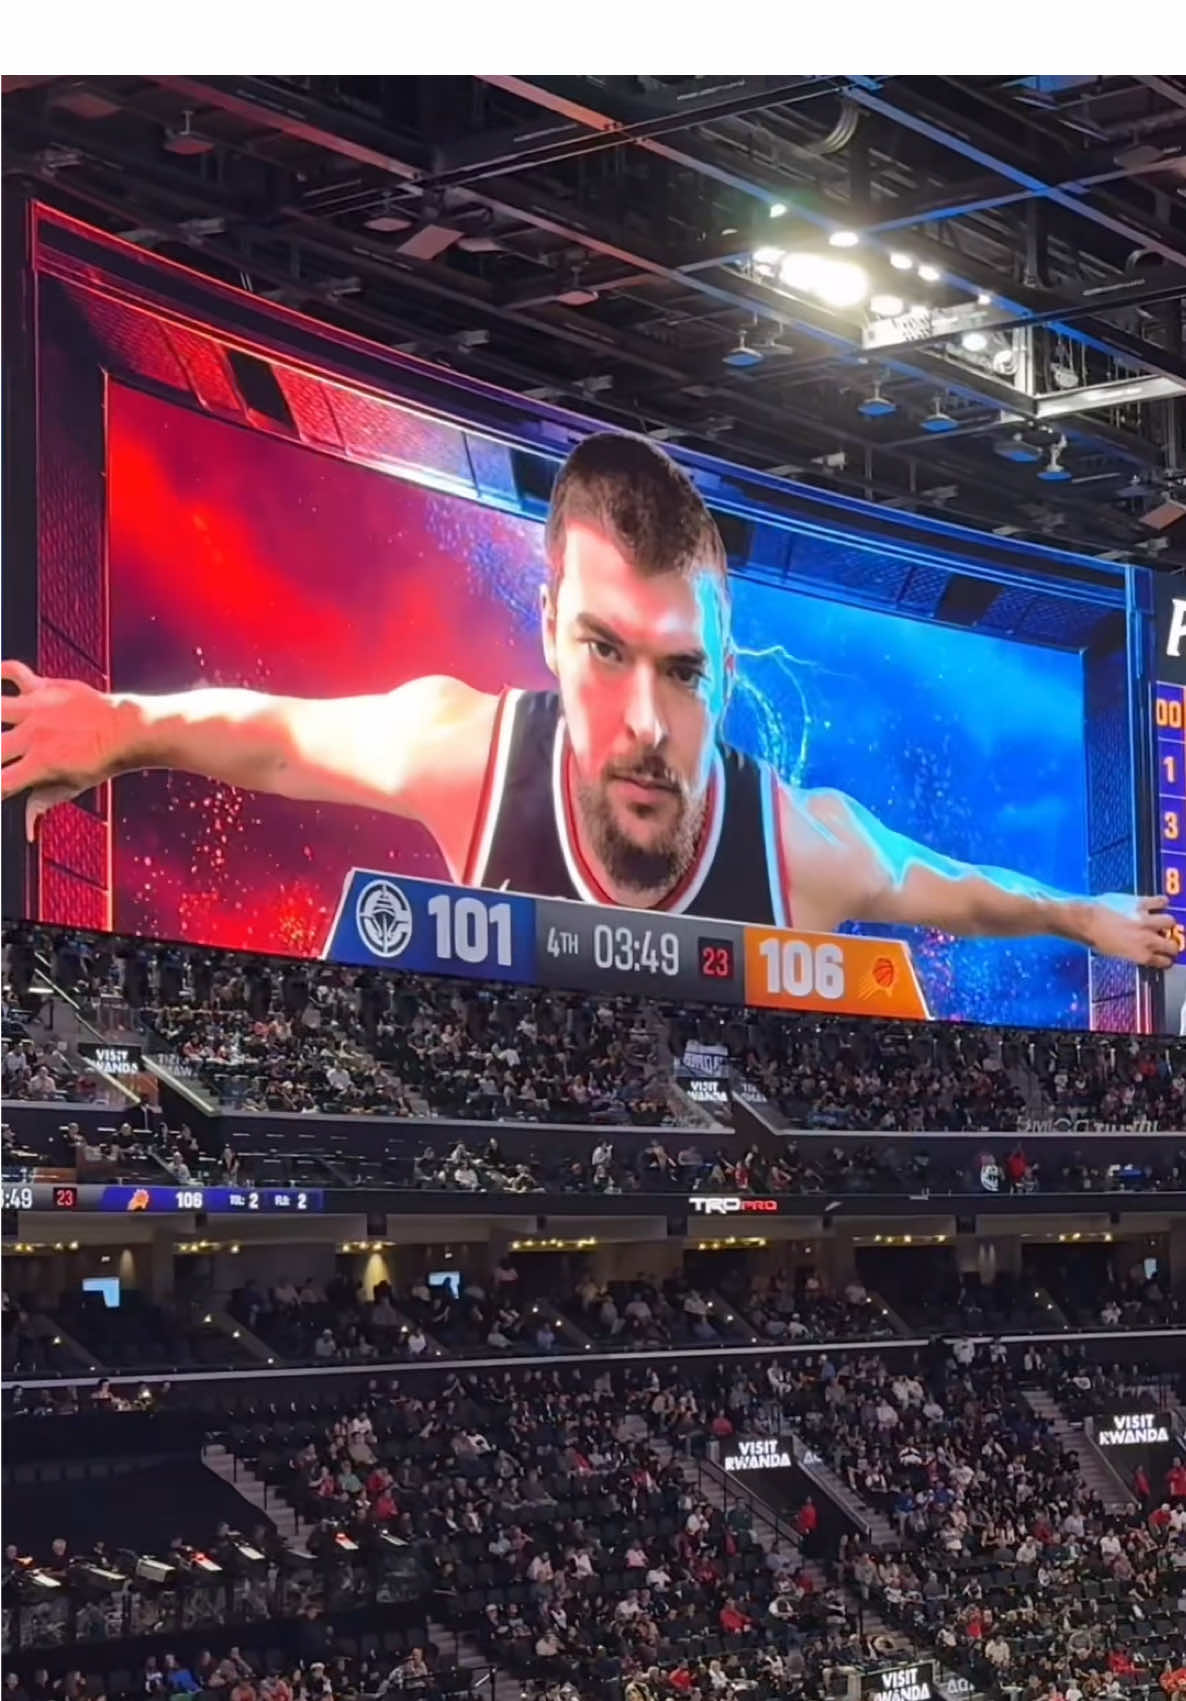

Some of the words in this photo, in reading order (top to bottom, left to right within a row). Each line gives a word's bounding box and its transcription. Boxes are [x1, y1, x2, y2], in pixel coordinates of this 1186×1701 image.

[1156, 698, 1183, 728] 00
[1163, 756, 1175, 783] 1
[1164, 811, 1179, 840] 3
[1165, 867, 1181, 896] 8
[428, 894, 512, 967] 101
[547, 927, 579, 958] 4TH
[593, 924, 680, 976] 03:49
[703, 947, 729, 976] 23
[759, 938, 845, 999] 106
[0, 1187, 33, 1209] :49
[56, 1189, 73, 1206] 23
[175, 1192, 203, 1209] 106
[249, 1192, 259, 1209] 2
[297, 1193, 307, 1209] 2
[1113, 1413, 1155, 1430] VISIT
[738, 1439, 778, 1456] VISIT
[1099, 1427, 1169, 1446] RWANDA
[724, 1452, 791, 1472] RWANDA
[881, 1668, 918, 1689] VISIT
